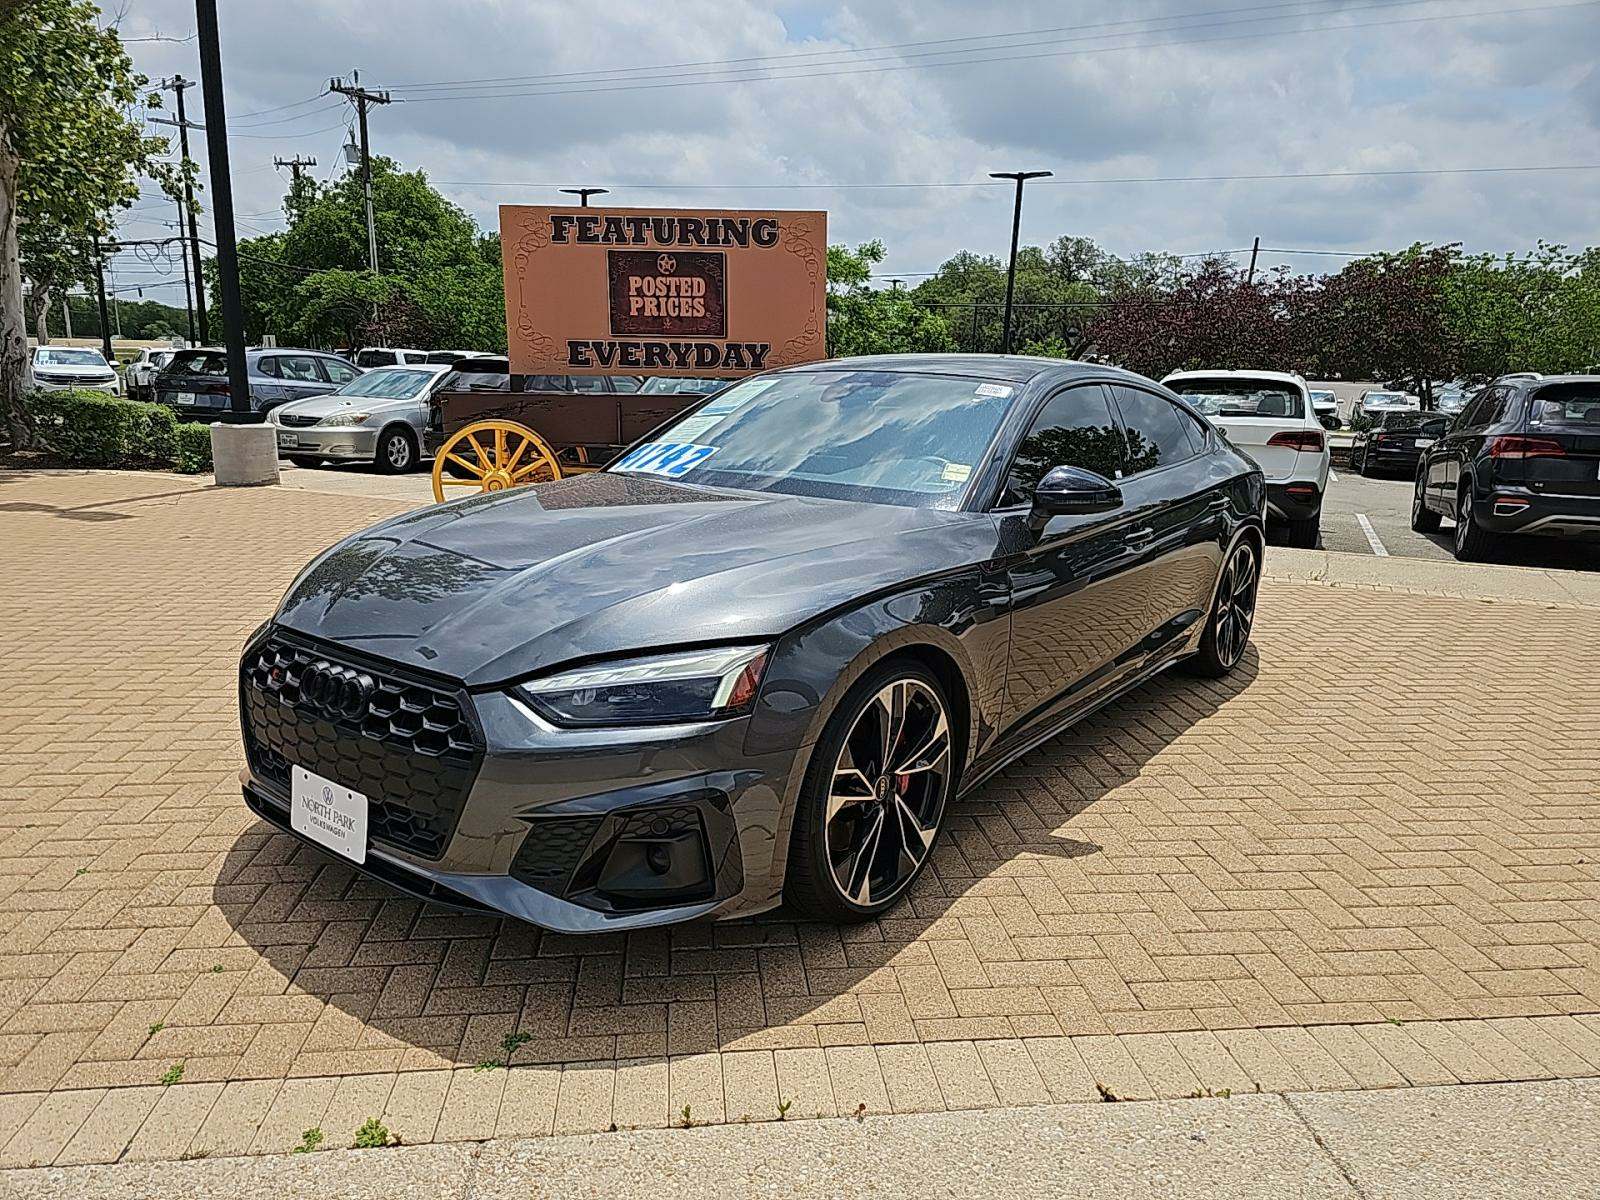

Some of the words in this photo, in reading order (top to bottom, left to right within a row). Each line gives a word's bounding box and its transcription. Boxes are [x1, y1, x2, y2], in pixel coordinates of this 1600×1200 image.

[549, 215, 779, 247] FEATURING
[628, 276, 706, 297] POSTED
[629, 296, 706, 317] PRICES
[566, 340, 771, 369] EVERYDAY
[301, 795, 331, 821] NORTH
[333, 810, 356, 833] PARK
[309, 814, 346, 838] VOLKSWAGEN
